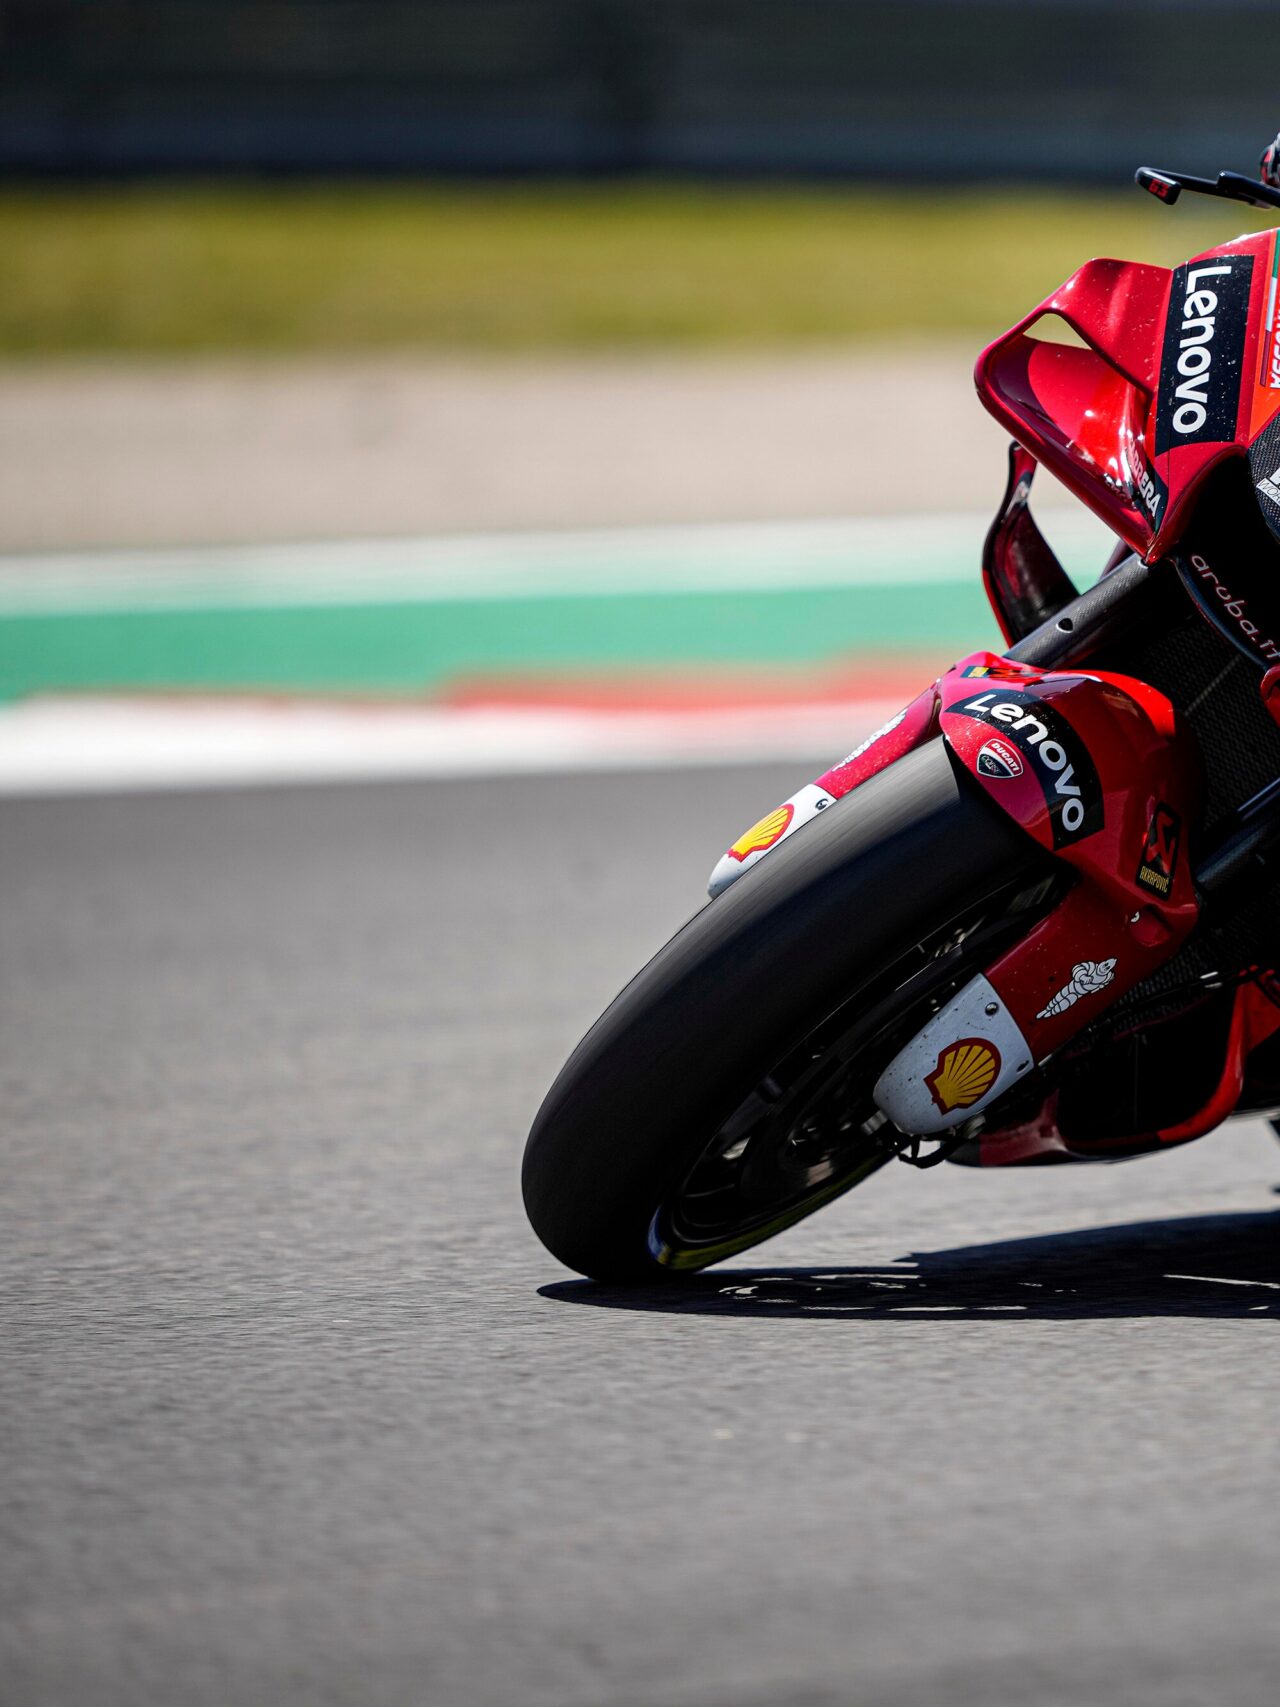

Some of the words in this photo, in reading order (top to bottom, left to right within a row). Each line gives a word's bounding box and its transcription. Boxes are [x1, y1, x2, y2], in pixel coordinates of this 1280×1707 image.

[1172, 265, 1232, 434] Lenovo
[964, 694, 1084, 831] Lenovo
[991, 742, 1020, 772] DUCATI
